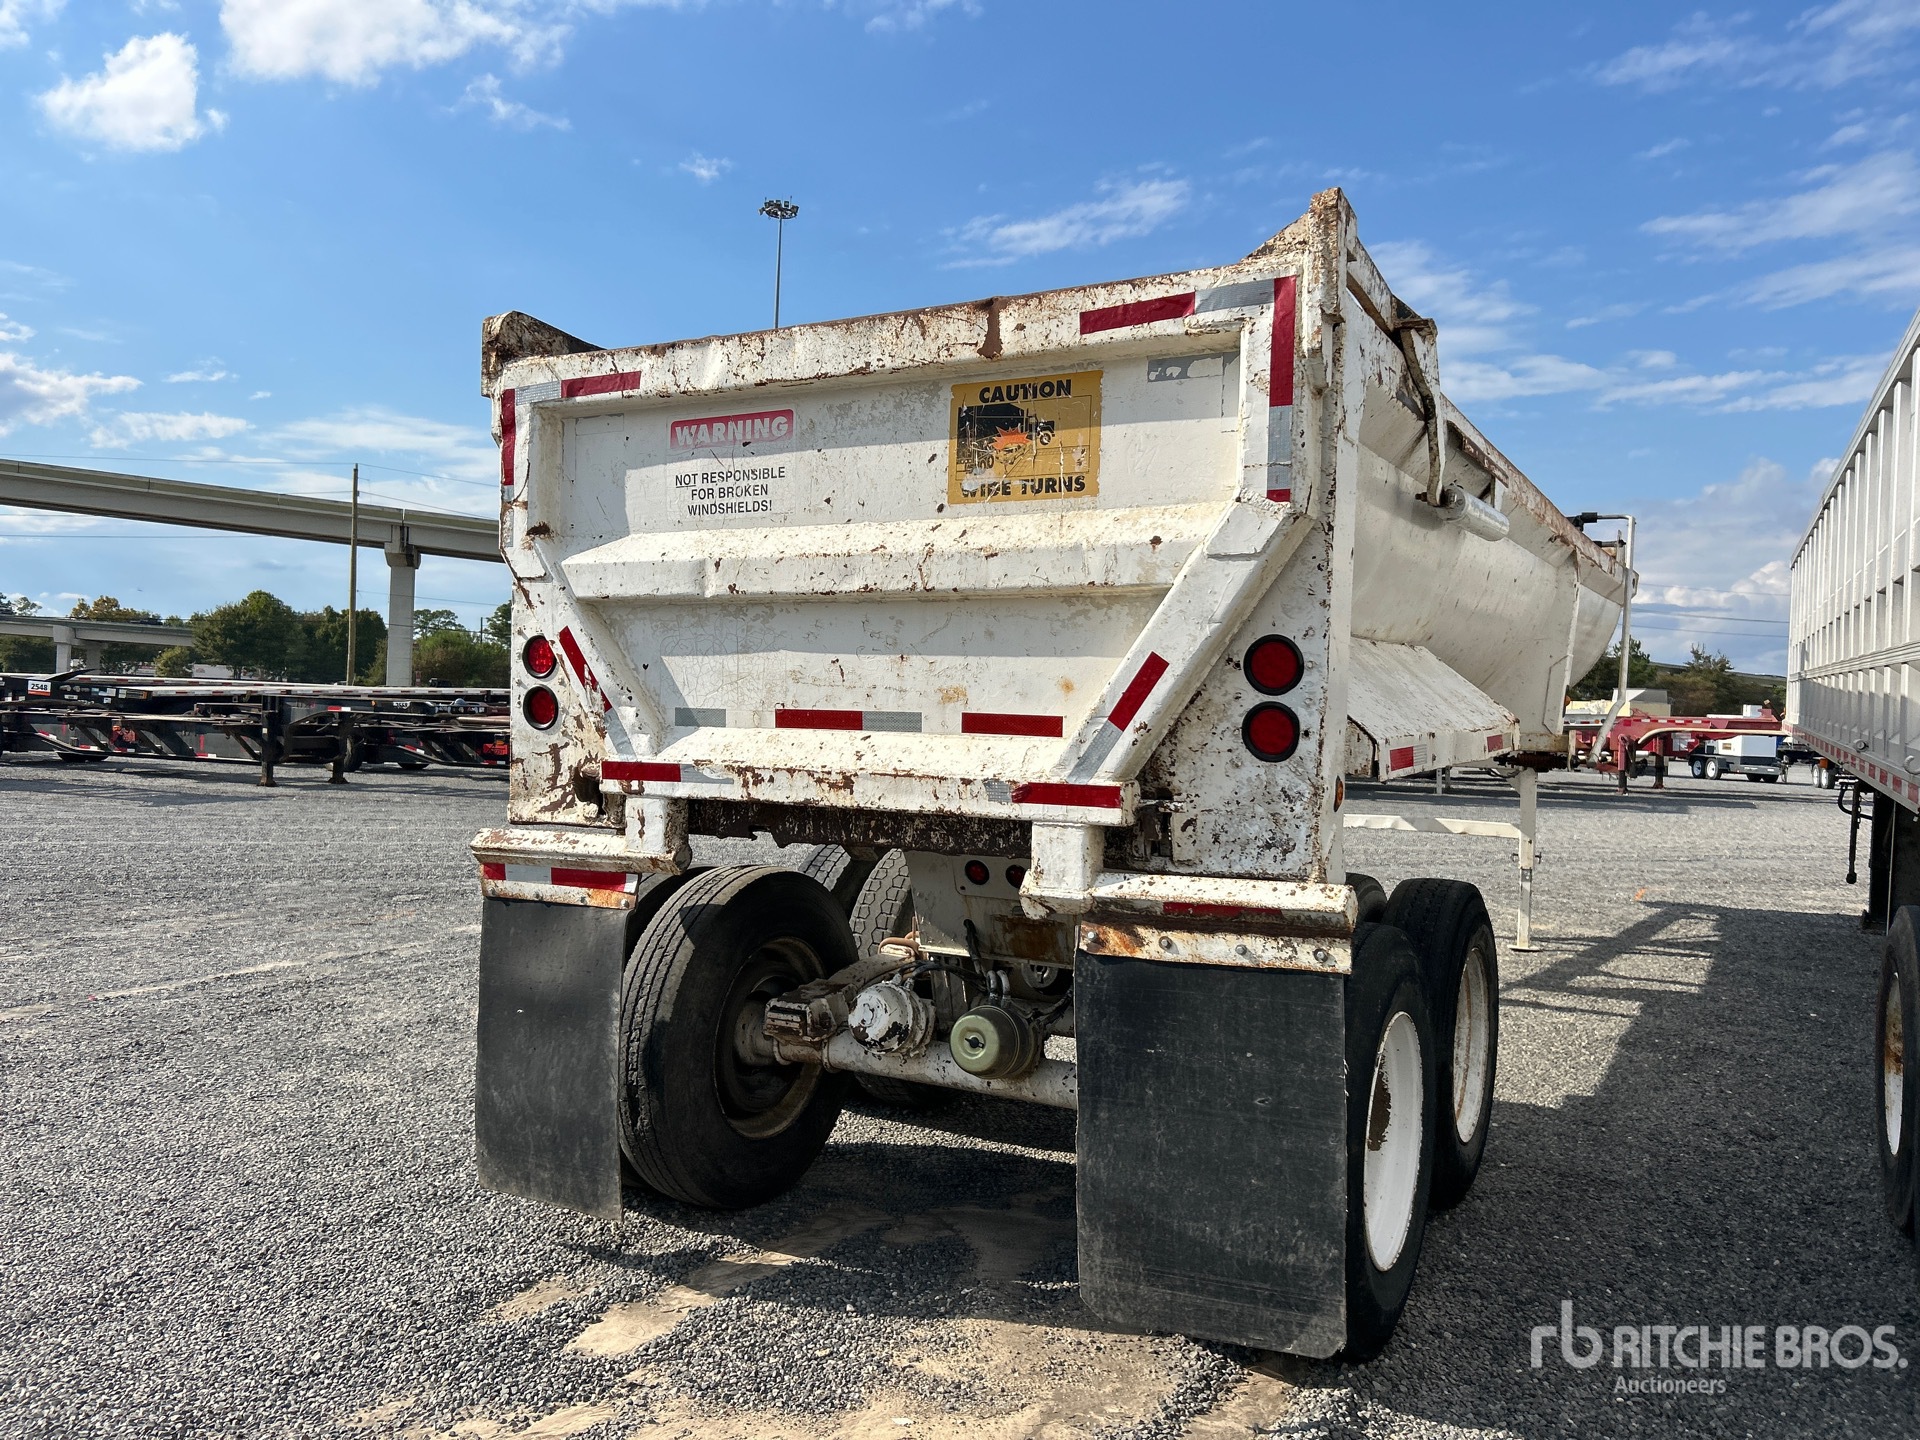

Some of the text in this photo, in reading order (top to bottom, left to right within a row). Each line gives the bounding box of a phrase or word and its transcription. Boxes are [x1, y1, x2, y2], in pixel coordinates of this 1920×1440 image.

[979, 379, 1071, 403] CAUTION
[675, 416, 789, 446] WARNING
[675, 467, 786, 487] NOT RESPONSIBLE
[1018, 475, 1086, 496] TURNS
[691, 484, 769, 501] FOR BROKEN
[687, 500, 773, 516] WINDSHIELDS!
[31, 683, 48, 691] 2548
